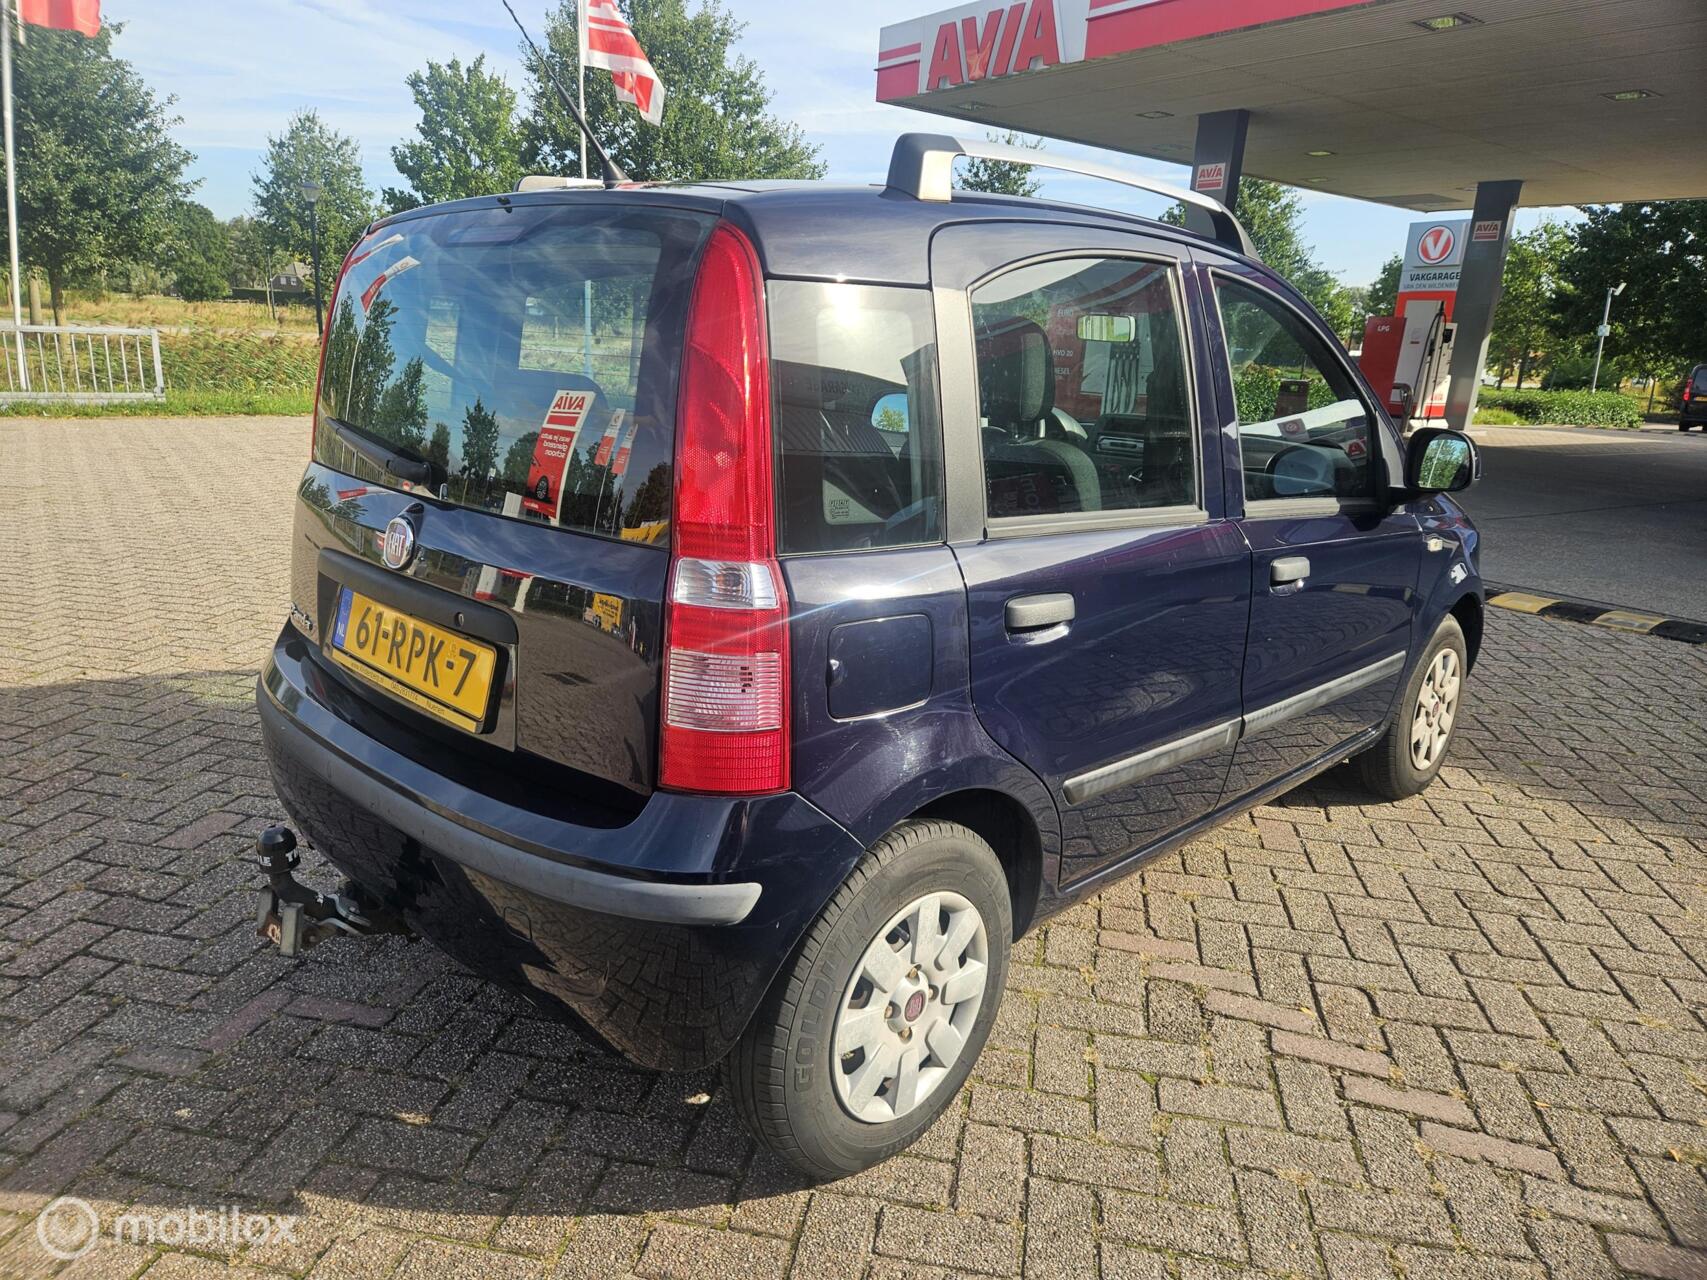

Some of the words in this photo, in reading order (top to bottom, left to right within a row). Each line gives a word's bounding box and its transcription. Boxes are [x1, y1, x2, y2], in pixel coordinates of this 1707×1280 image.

[927, 0, 1060, 90] AVIA
[1199, 165, 1223, 178] AVIA
[1476, 221, 1498, 232] AVIA
[1410, 272, 1461, 281] VAKGARAGE
[1377, 324, 1391, 332] LPG
[389, 532, 405, 557] FIAT
[356, 606, 477, 697] 61-RPK-7
